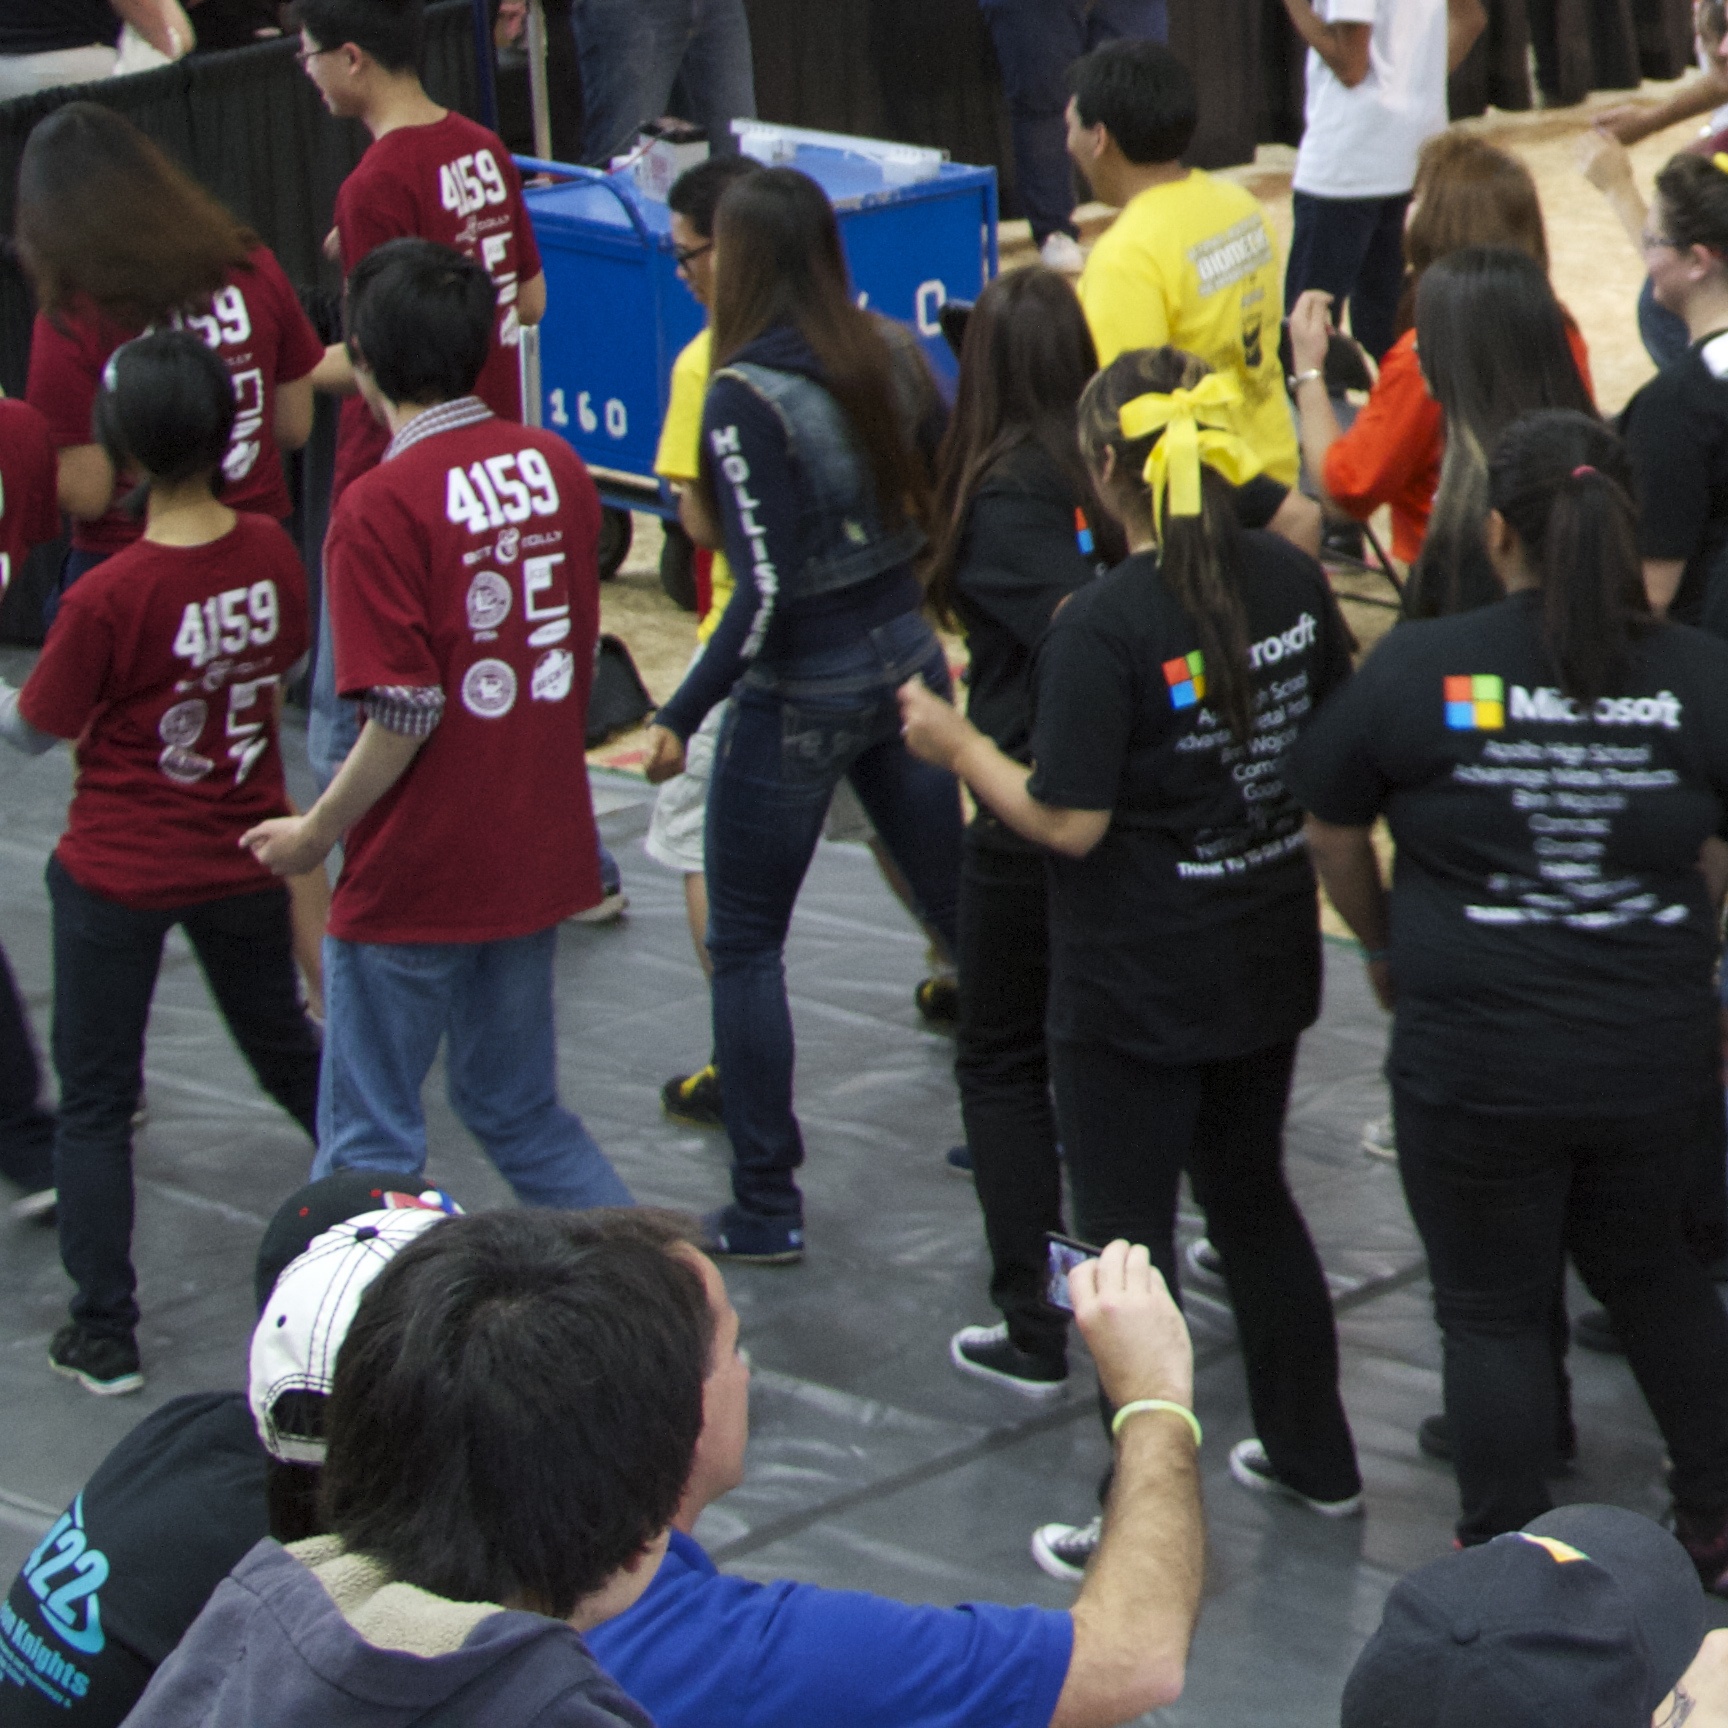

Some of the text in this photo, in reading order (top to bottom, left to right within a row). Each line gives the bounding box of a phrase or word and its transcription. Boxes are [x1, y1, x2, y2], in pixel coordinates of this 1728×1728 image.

[439, 147, 508, 219] 4159
[446, 447, 561, 535] 4159
[173, 579, 280, 668] 4159
[1509, 685, 1683, 730] Micosoft
